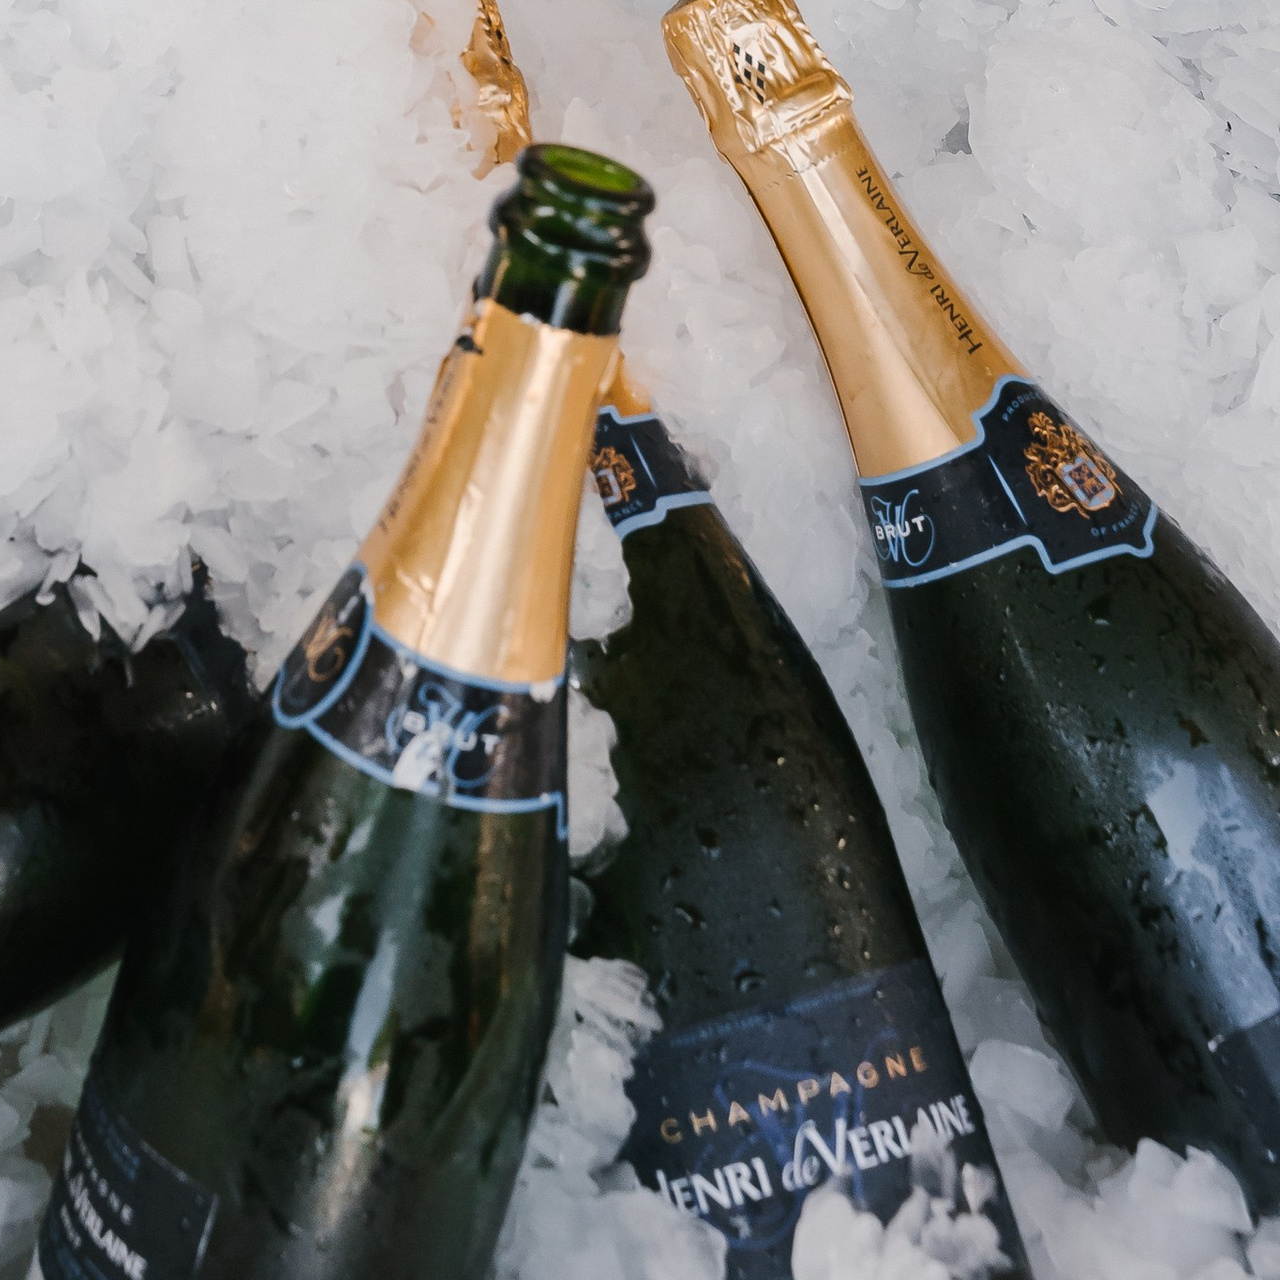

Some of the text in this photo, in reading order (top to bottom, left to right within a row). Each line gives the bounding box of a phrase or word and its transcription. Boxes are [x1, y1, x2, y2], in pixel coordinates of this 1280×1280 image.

[855, 166, 920, 271] VERLAINE
[930, 284, 983, 355] HENRI
[875, 515, 925, 540] BRUT
[660, 1046, 928, 1144] CHAMPAGNE
